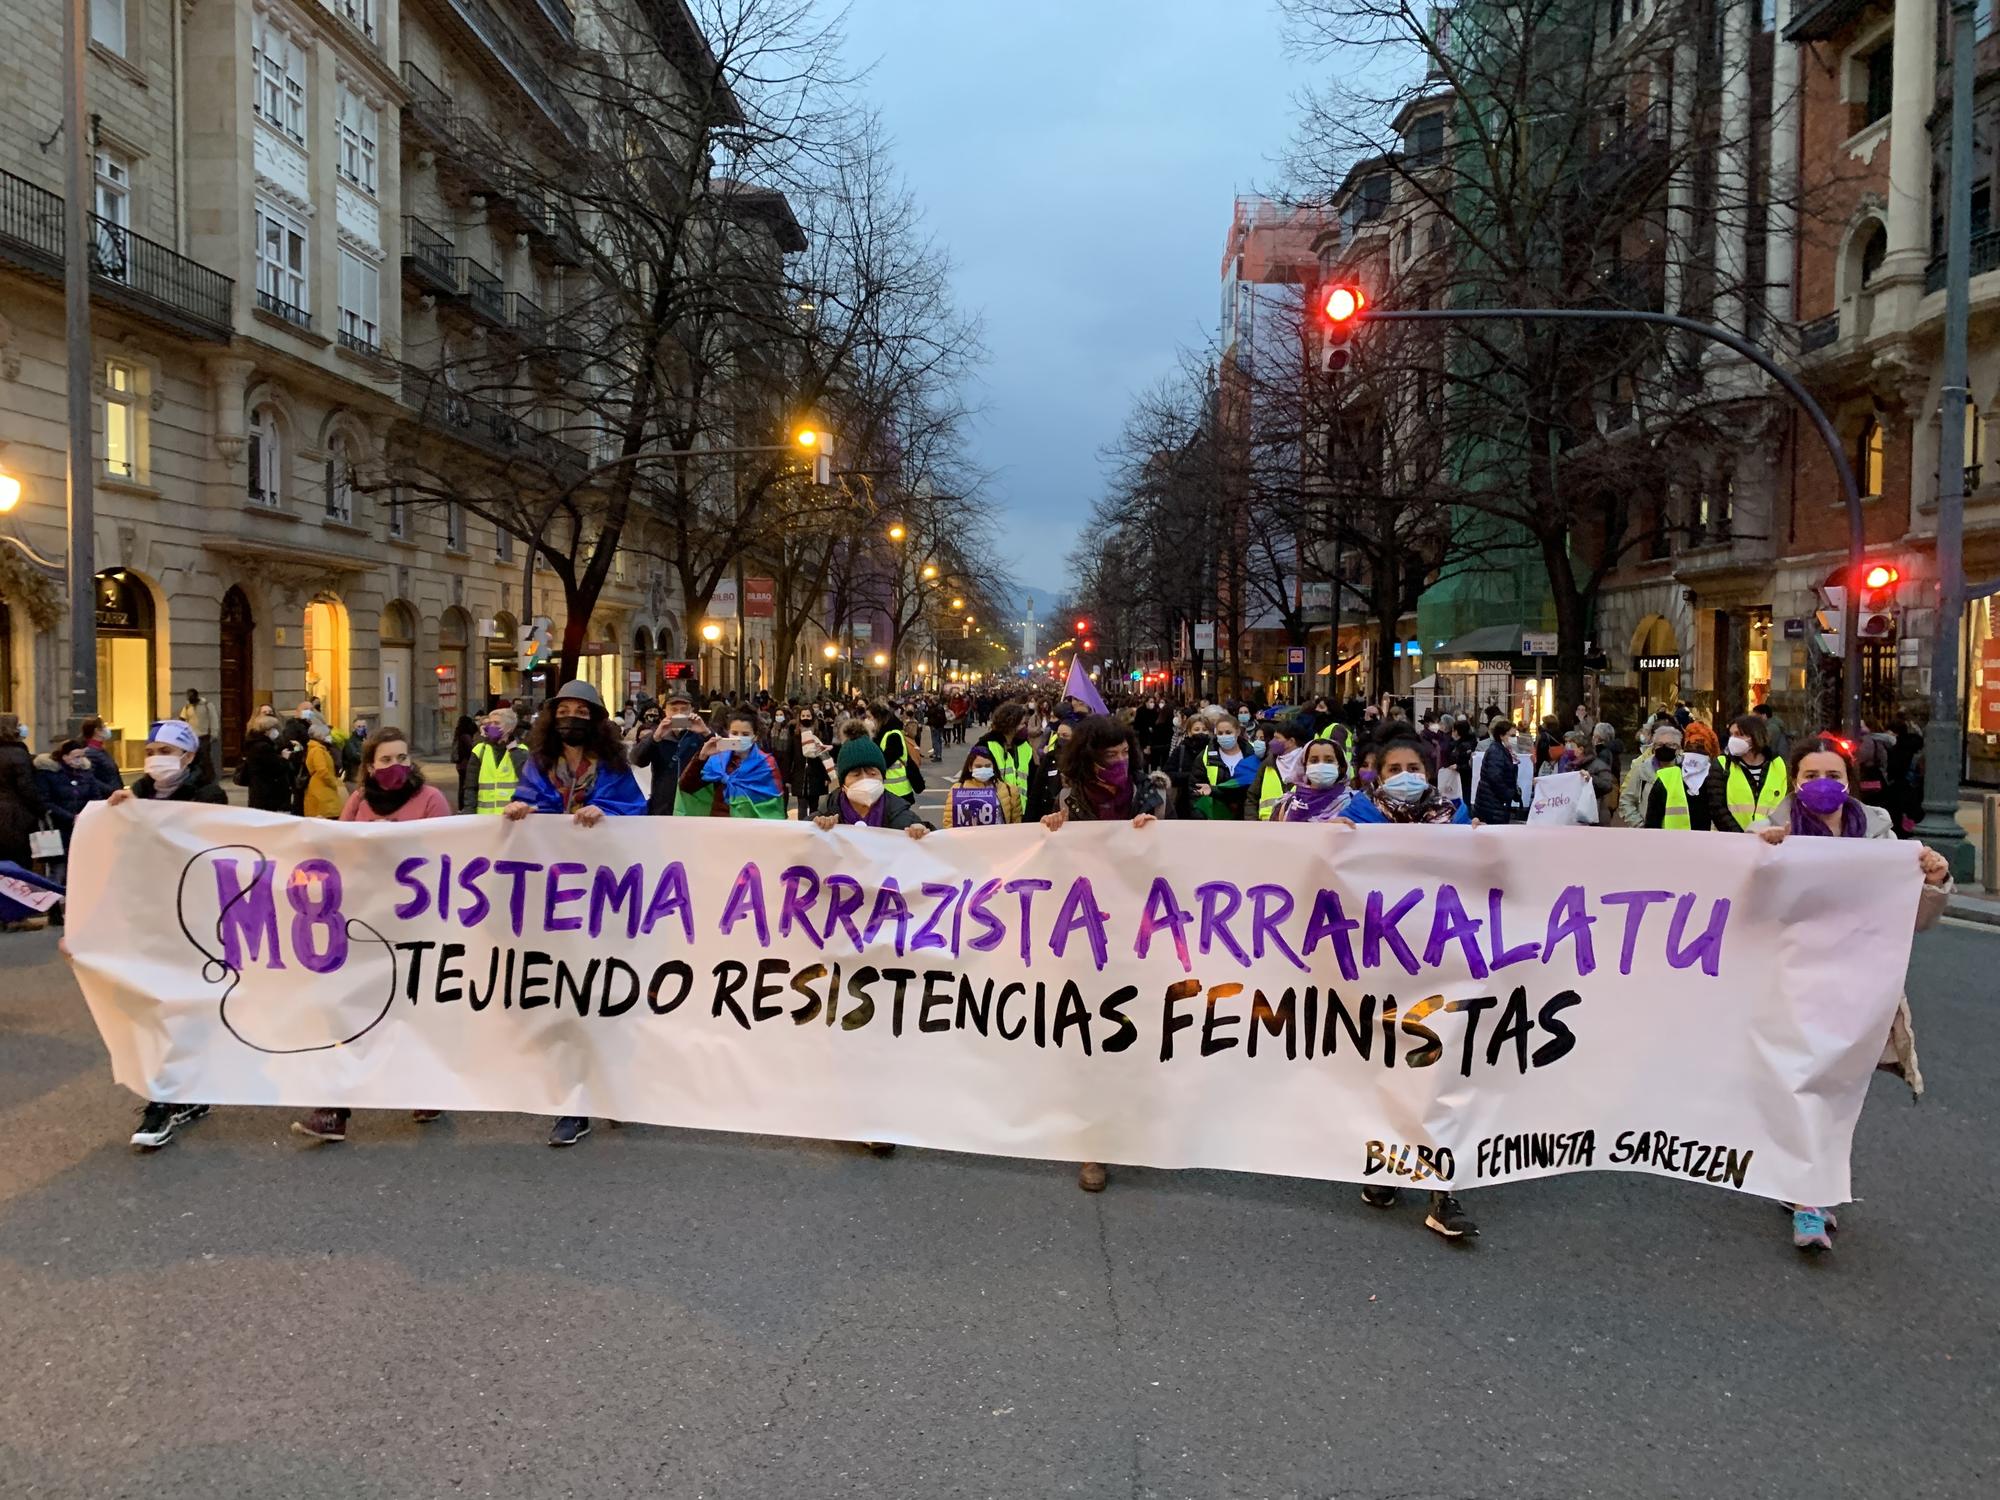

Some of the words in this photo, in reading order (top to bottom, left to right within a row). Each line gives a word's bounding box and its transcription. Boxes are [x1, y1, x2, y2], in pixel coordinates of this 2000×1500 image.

[747, 592, 772, 601] BILBAO
[213, 857, 350, 974] M8
[394, 855, 694, 944] SISTEMA
[718, 860, 1111, 972] ARRAZISTA
[1133, 875, 1732, 979] ARRAKALATU
[395, 940, 694, 1018] TEJIENDO
[711, 960, 1139, 1058] RESISTENCIAS
[1158, 979, 1583, 1078] FEMINISTAS
[1362, 1139, 1456, 1183] BILBO
[1477, 1129, 1597, 1179] FEMINISTA
[1608, 1130, 1754, 1189] SARETZEN
